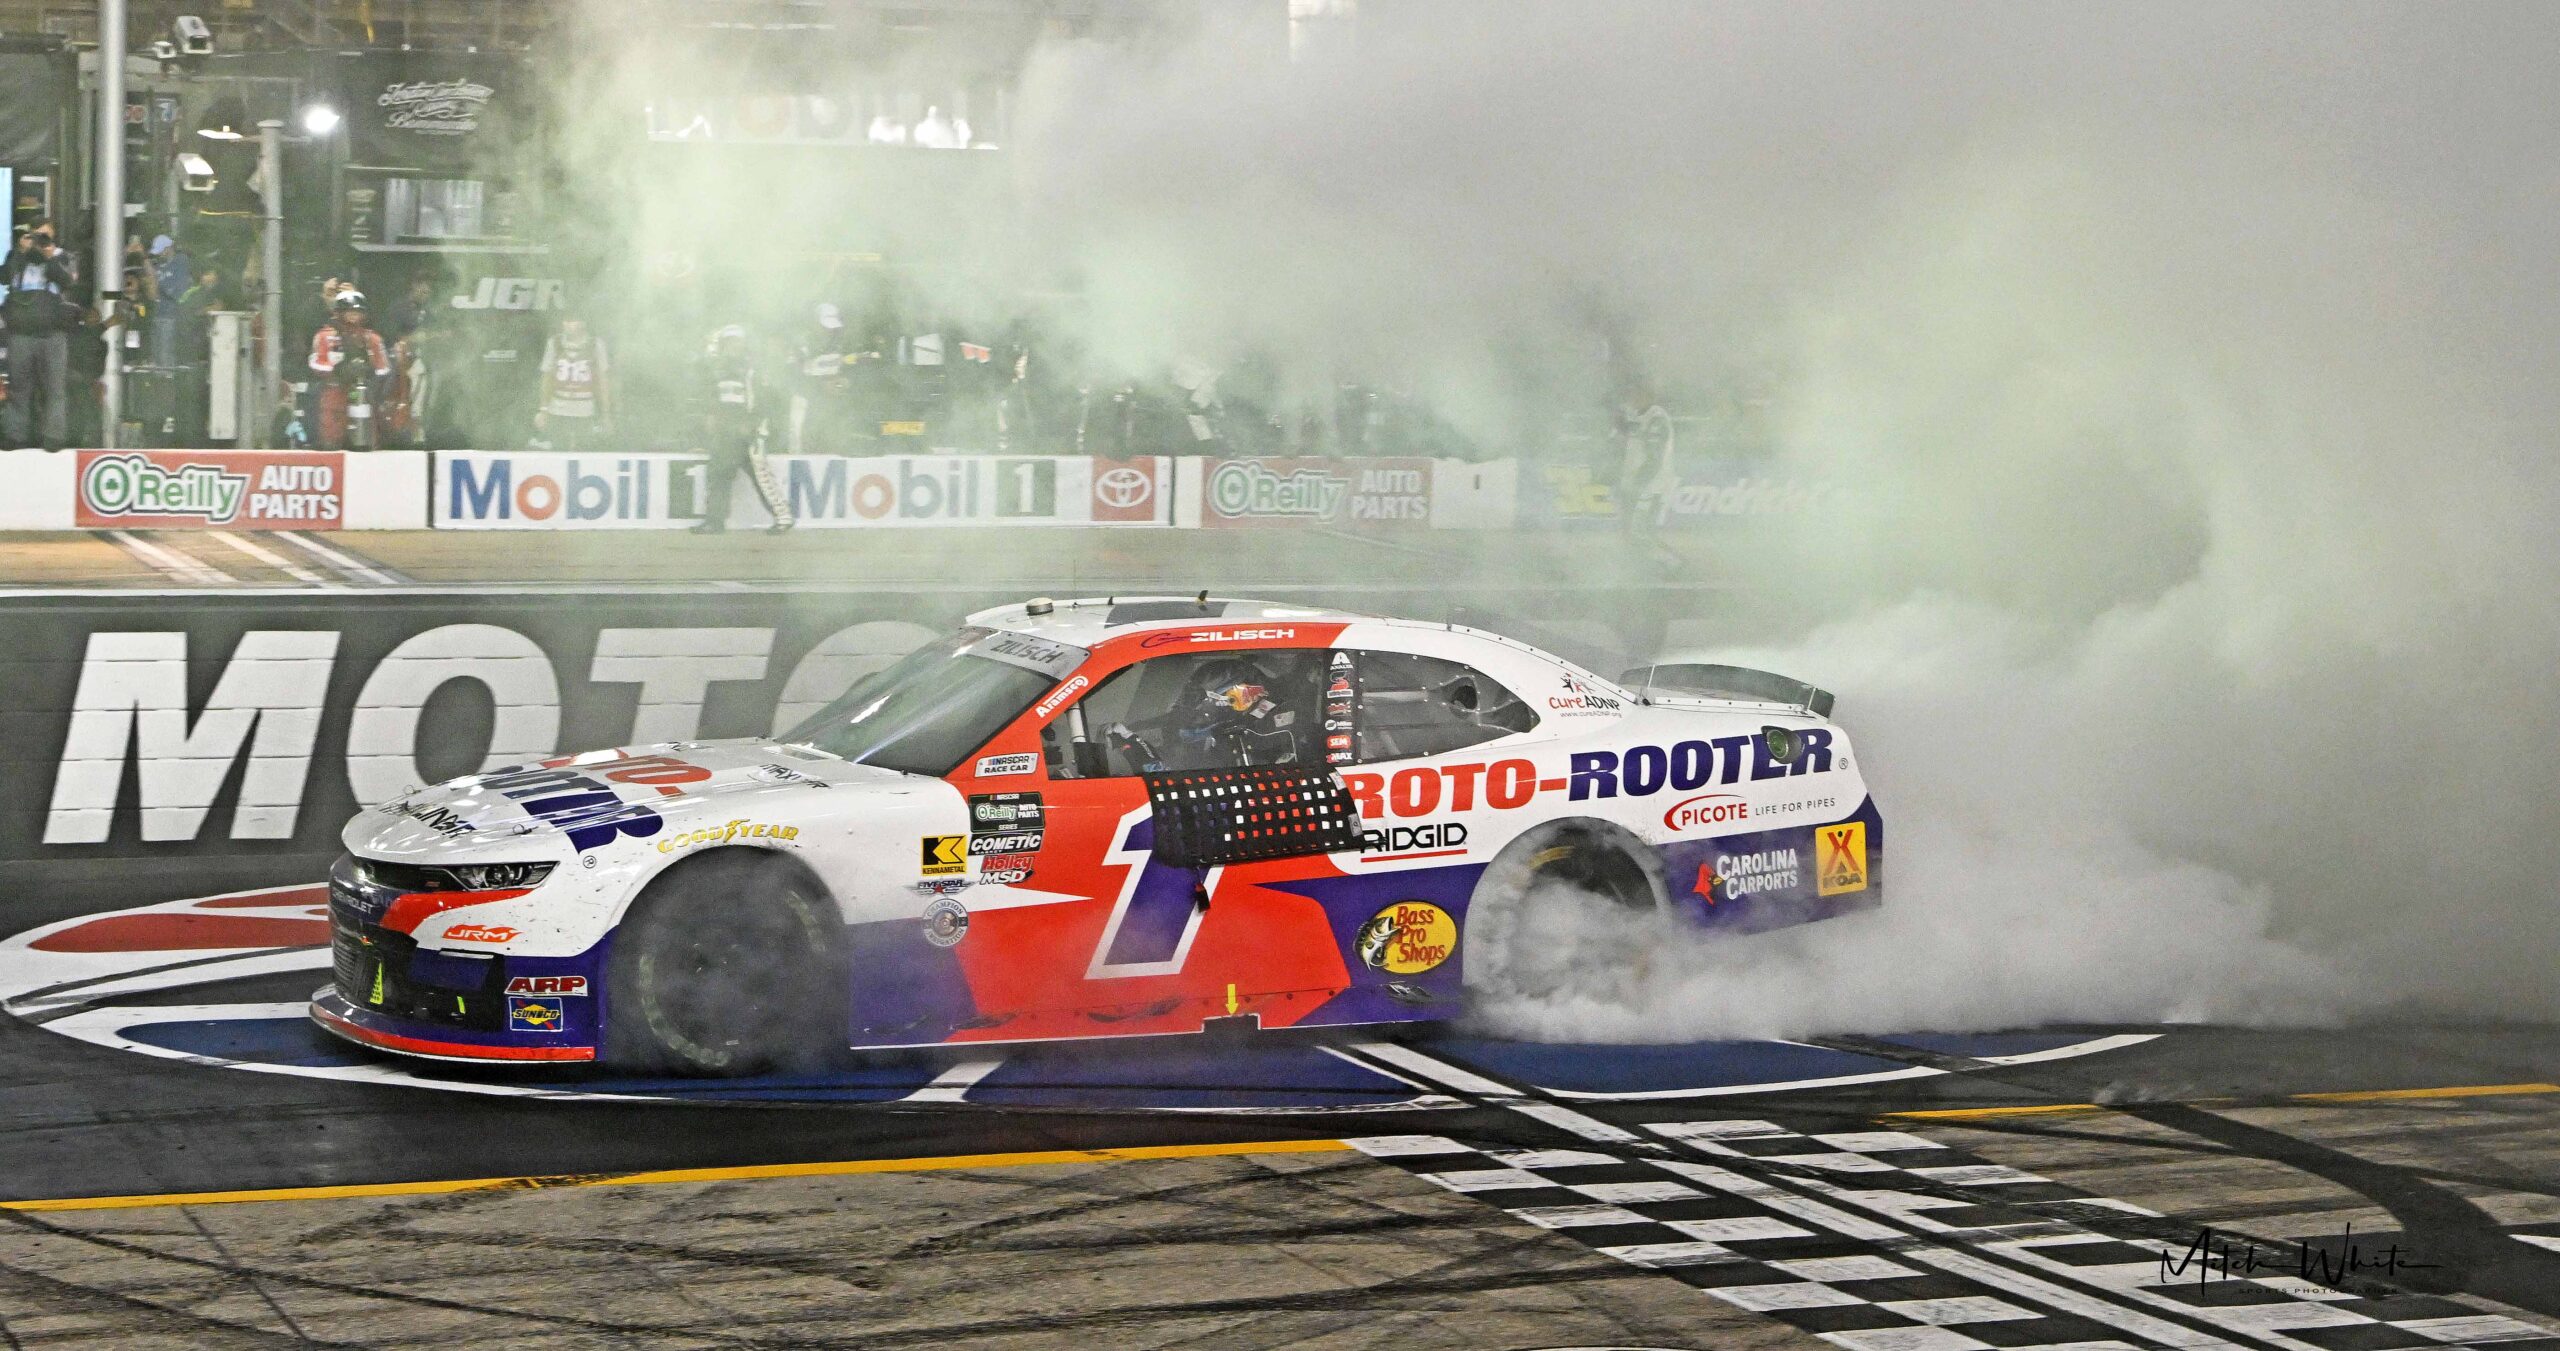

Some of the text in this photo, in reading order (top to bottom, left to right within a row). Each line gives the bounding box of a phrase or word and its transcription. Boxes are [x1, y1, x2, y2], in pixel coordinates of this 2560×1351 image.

[451, 277, 565, 312] JGR
[91, 459, 244, 516] O'Reilly
[260, 465, 333, 491] AUTO
[449, 459, 707, 521] Mobil 1
[788, 459, 1035, 520] Mobil 1
[1359, 469, 1422, 494] AUTO
[1217, 466, 1347, 520] O'Reilly
[250, 493, 340, 520] PARTS
[1351, 496, 1429, 520] PARTS
[1190, 628, 1295, 644] ZILISCH
[991, 640, 1065, 664] ZILISCH
[1035, 675, 1089, 718] Aramsco
[984, 764, 1028, 774] RACE CAR
[994, 755, 1030, 765] NASCAR
[1340, 728, 1833, 819] ROTO-ROOTER
[977, 804, 1017, 820] O'Reilly
[1018, 810, 1040, 818] PARTS
[1682, 797, 1836, 826] PICOTE LIFE FOR PIPES
[657, 819, 799, 853] GOODYEAR
[971, 834, 1042, 852] COMETIC
[1360, 823, 1468, 854] RIDGID
[923, 866, 966, 875] KENNAMETAL
[981, 854, 1035, 873] Holley
[1716, 848, 1799, 880] CAROLINA
[980, 870, 1028, 886] MSD
[1725, 871, 1799, 900] CARPORTS
[1823, 872, 1863, 889] KOA
[1083, 800, 1227, 981] 1
[1395, 905, 1435, 927] Bass
[448, 929, 507, 940] JRM
[1396, 925, 1427, 944] Pro
[1396, 943, 1447, 966] Shops
[506, 976, 586, 992] ARP
[514, 1009, 558, 1019] SUNOCO
